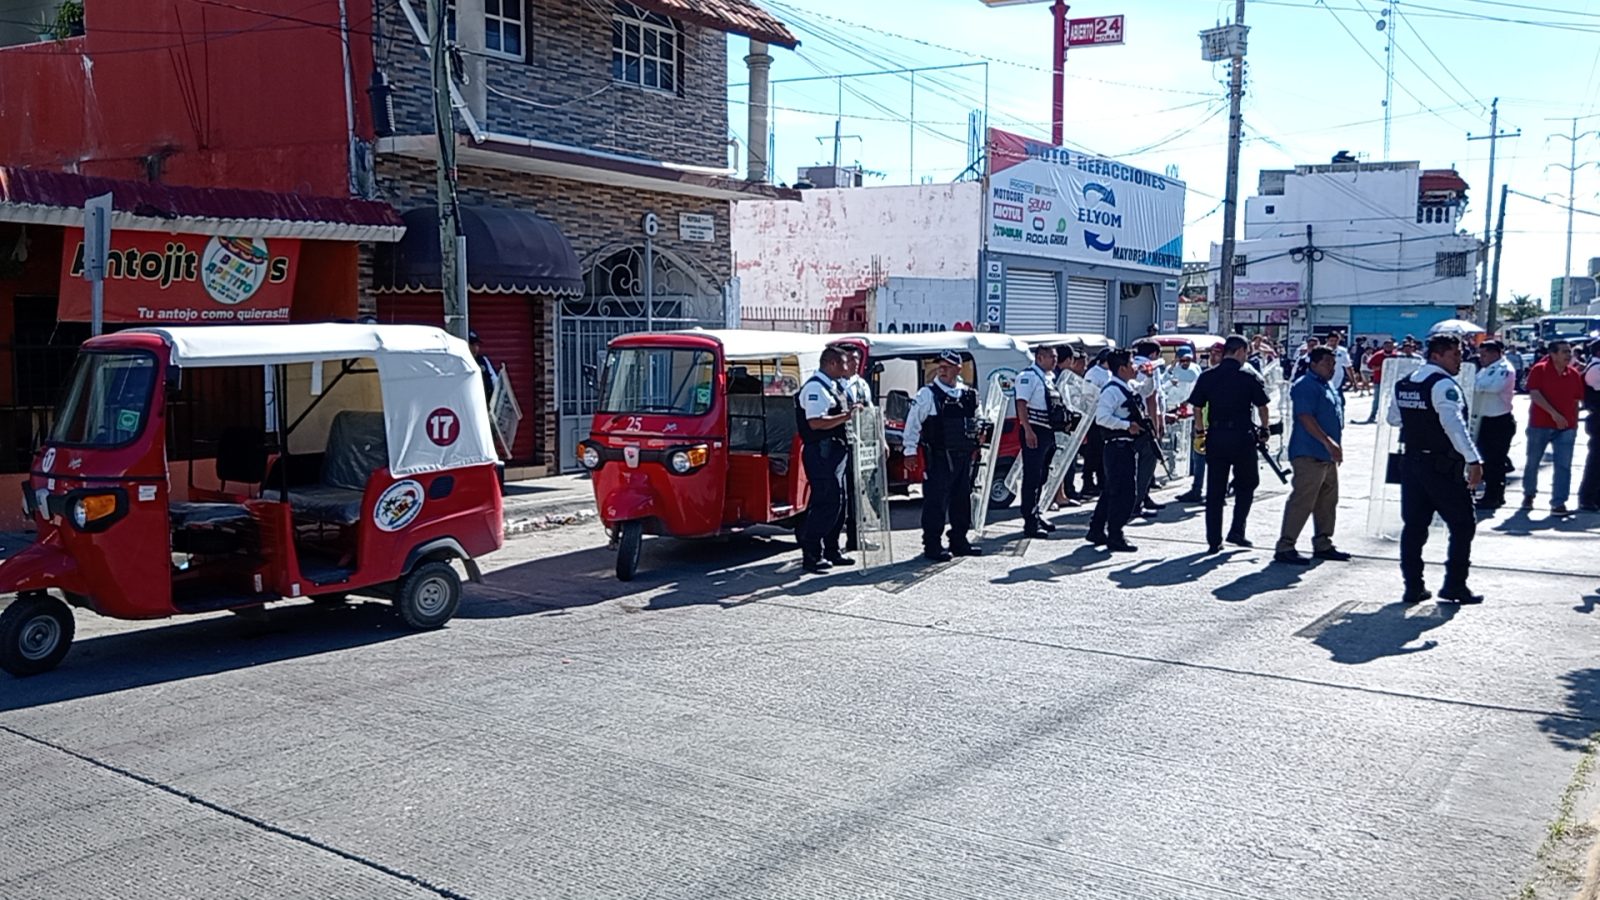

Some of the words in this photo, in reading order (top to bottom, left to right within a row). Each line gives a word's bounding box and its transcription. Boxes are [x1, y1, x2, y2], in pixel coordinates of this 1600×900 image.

[1071, 23, 1093, 40] ABIERTO
[1095, 18, 1120, 35] 24
[1024, 140, 1069, 165] MOTO
[1077, 155, 1166, 190] REFACCIONES
[993, 187, 1024, 203] MOTOCORE
[994, 204, 1022, 221] MOTUL
[1078, 207, 1122, 228] ELYOM
[645, 212, 658, 237] 6
[1026, 232, 1048, 245] RODA
[1049, 233, 1068, 246] GHIRA
[205, 262, 253, 294] APETITO
[138, 307, 153, 319] Tu
[158, 307, 198, 321] antojo
[201, 310, 234, 319] como
[236, 307, 289, 320] quieras!!!
[430, 415, 453, 439] 17
[626, 416, 642, 432] 25
